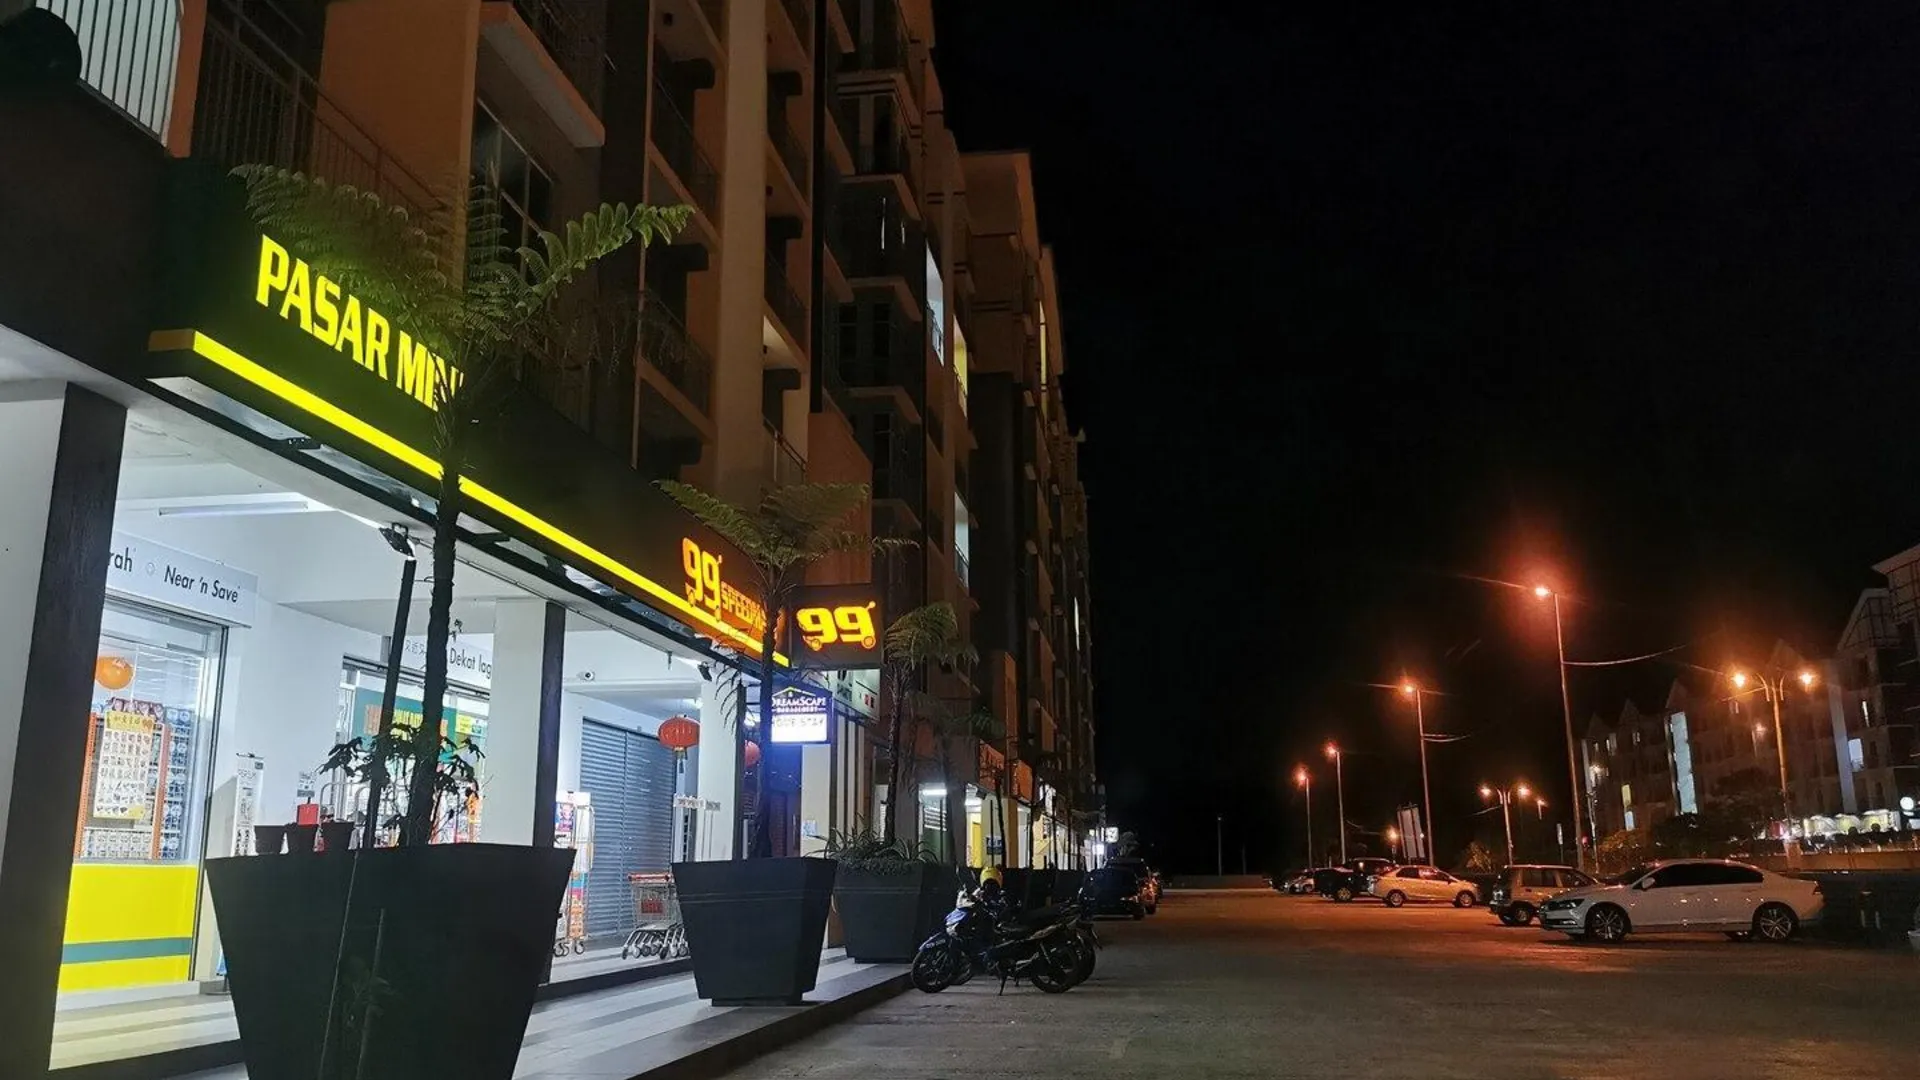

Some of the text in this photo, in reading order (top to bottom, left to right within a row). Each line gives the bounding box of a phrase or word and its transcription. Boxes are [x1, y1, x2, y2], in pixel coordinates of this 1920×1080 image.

[256, 233, 391, 381] PASAR
[163, 564, 195, 591] Near
[211, 579, 239, 603] Save
[682, 537, 722, 621] 99
[796, 601, 877, 652] 99
[450, 648, 475, 670] Dekat
